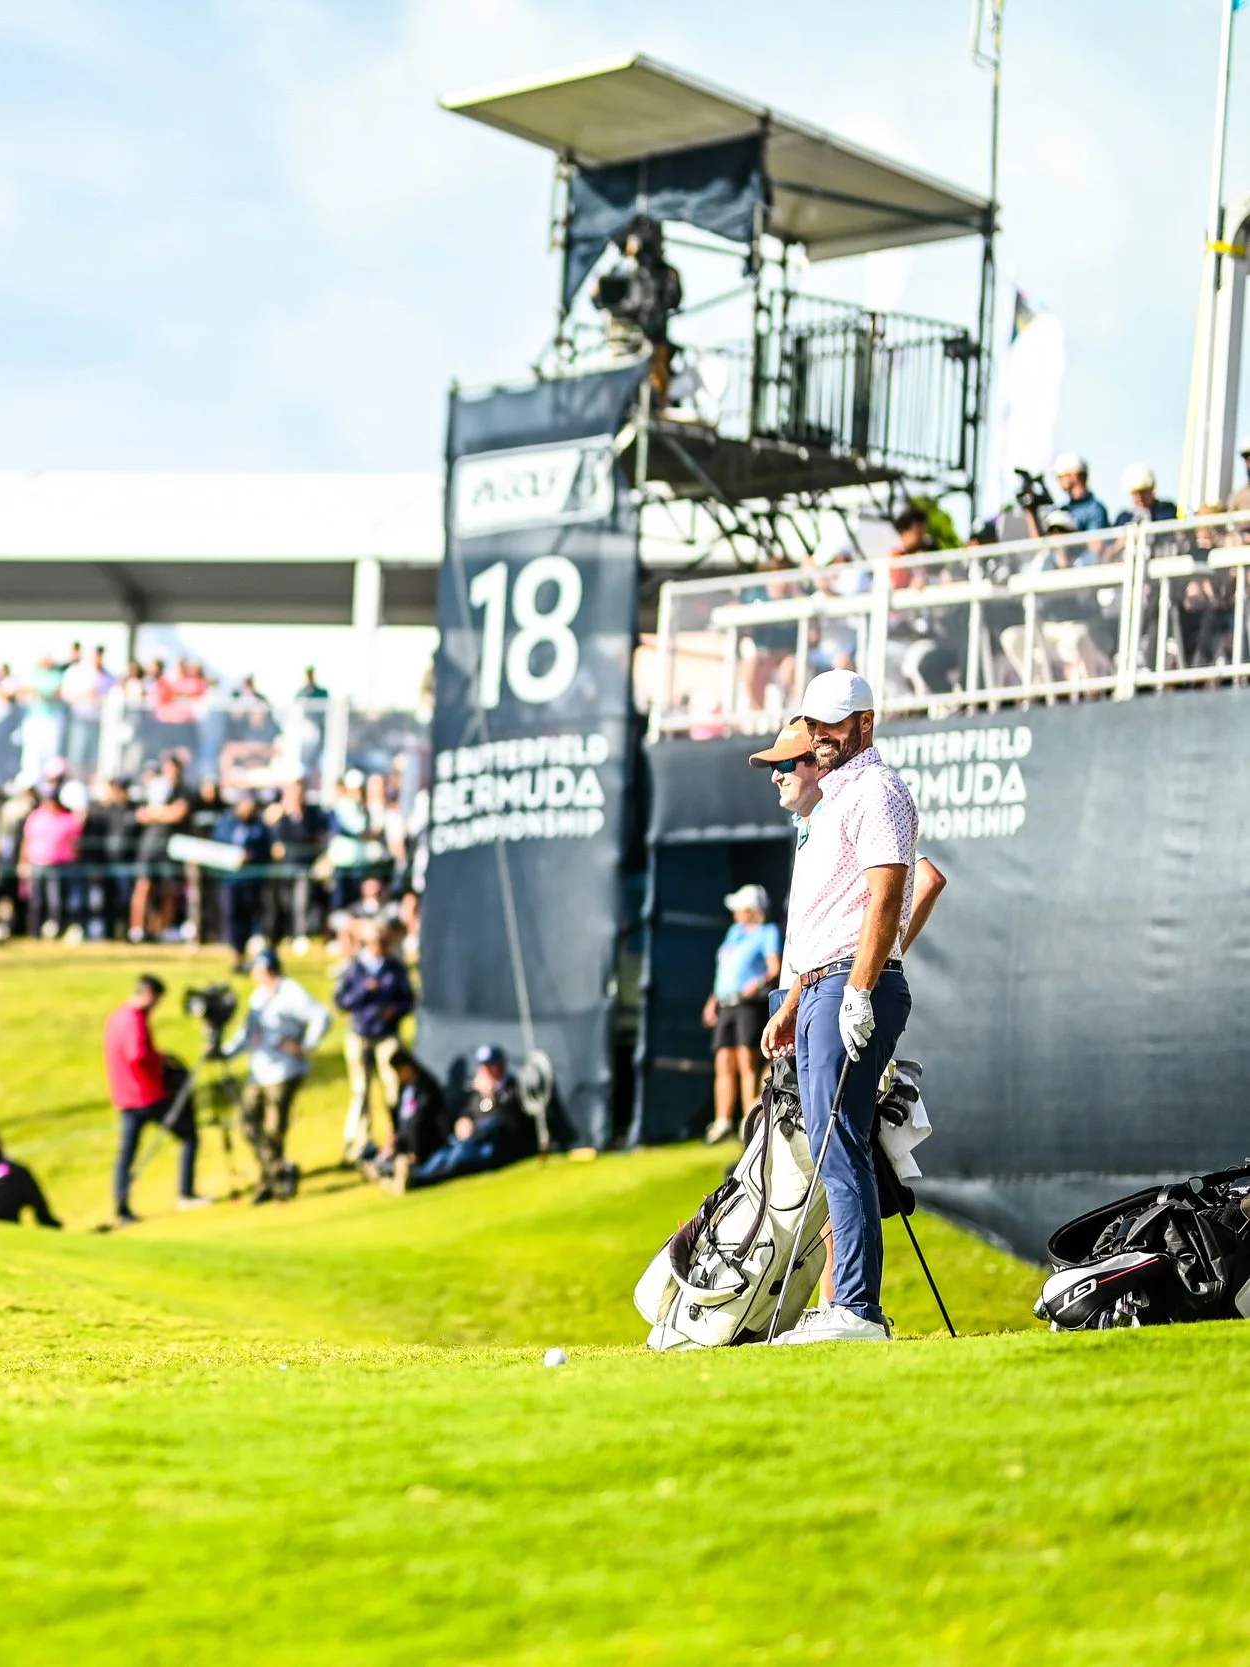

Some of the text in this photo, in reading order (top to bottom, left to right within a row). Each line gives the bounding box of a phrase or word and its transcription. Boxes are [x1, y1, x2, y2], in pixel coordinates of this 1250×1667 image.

[470, 555, 583, 709] 18
[433, 766, 604, 823] BERMUDA
[898, 761, 1026, 808] RMUDA
[919, 804, 1026, 842] IONSHIP
